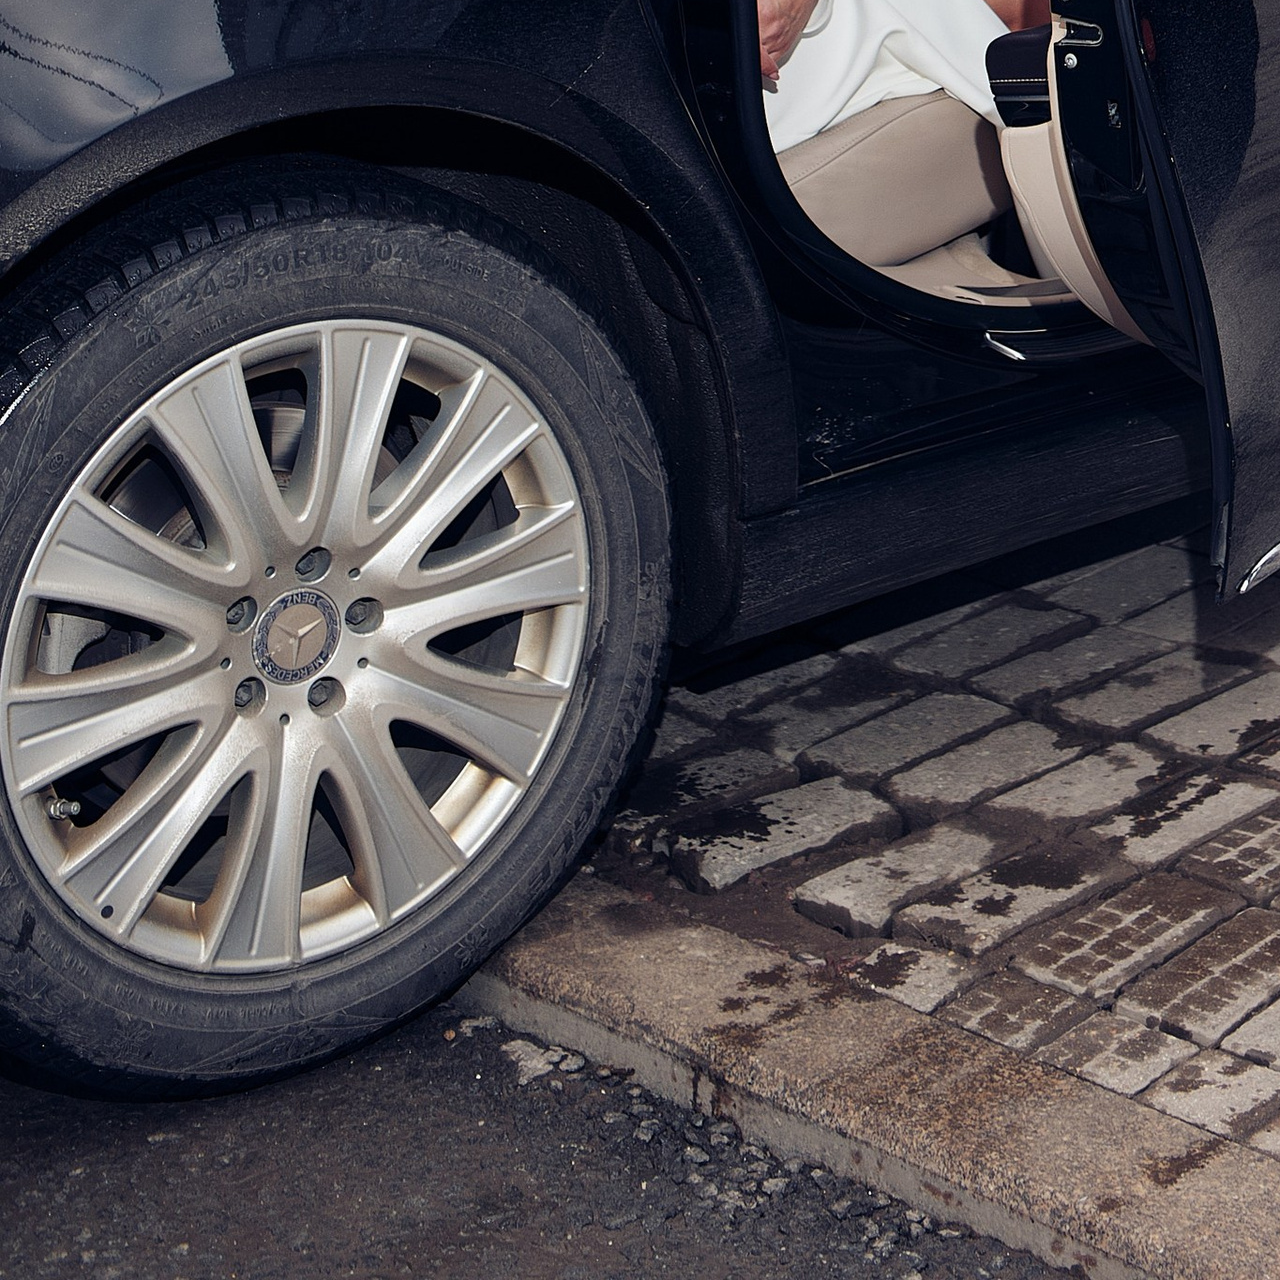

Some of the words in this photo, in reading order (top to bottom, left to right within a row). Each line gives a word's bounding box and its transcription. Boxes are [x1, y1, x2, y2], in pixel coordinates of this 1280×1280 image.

[285, 593, 317, 607] BENZ
[264, 656, 325, 681] MERCEDES
[524, 640, 656, 897] TRIANGLE
